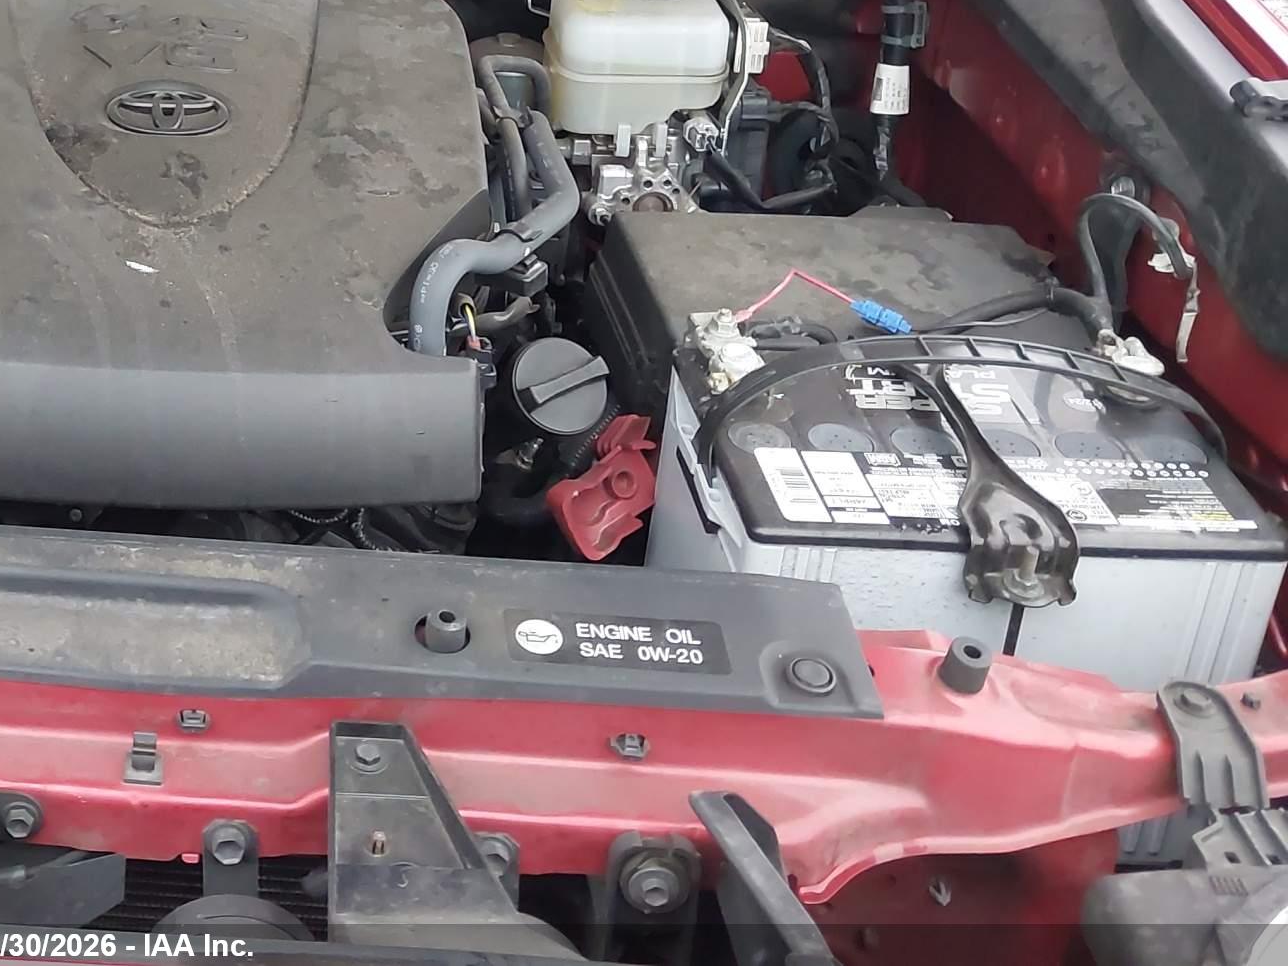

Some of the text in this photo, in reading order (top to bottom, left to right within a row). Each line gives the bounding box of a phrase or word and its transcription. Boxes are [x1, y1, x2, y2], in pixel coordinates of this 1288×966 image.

[846, 379, 1011, 403] STRT
[854, 395, 1003, 415] SPER
[576, 622, 702, 645] ENGINE OIL
[579, 643, 704, 665] SAE 0W-20
